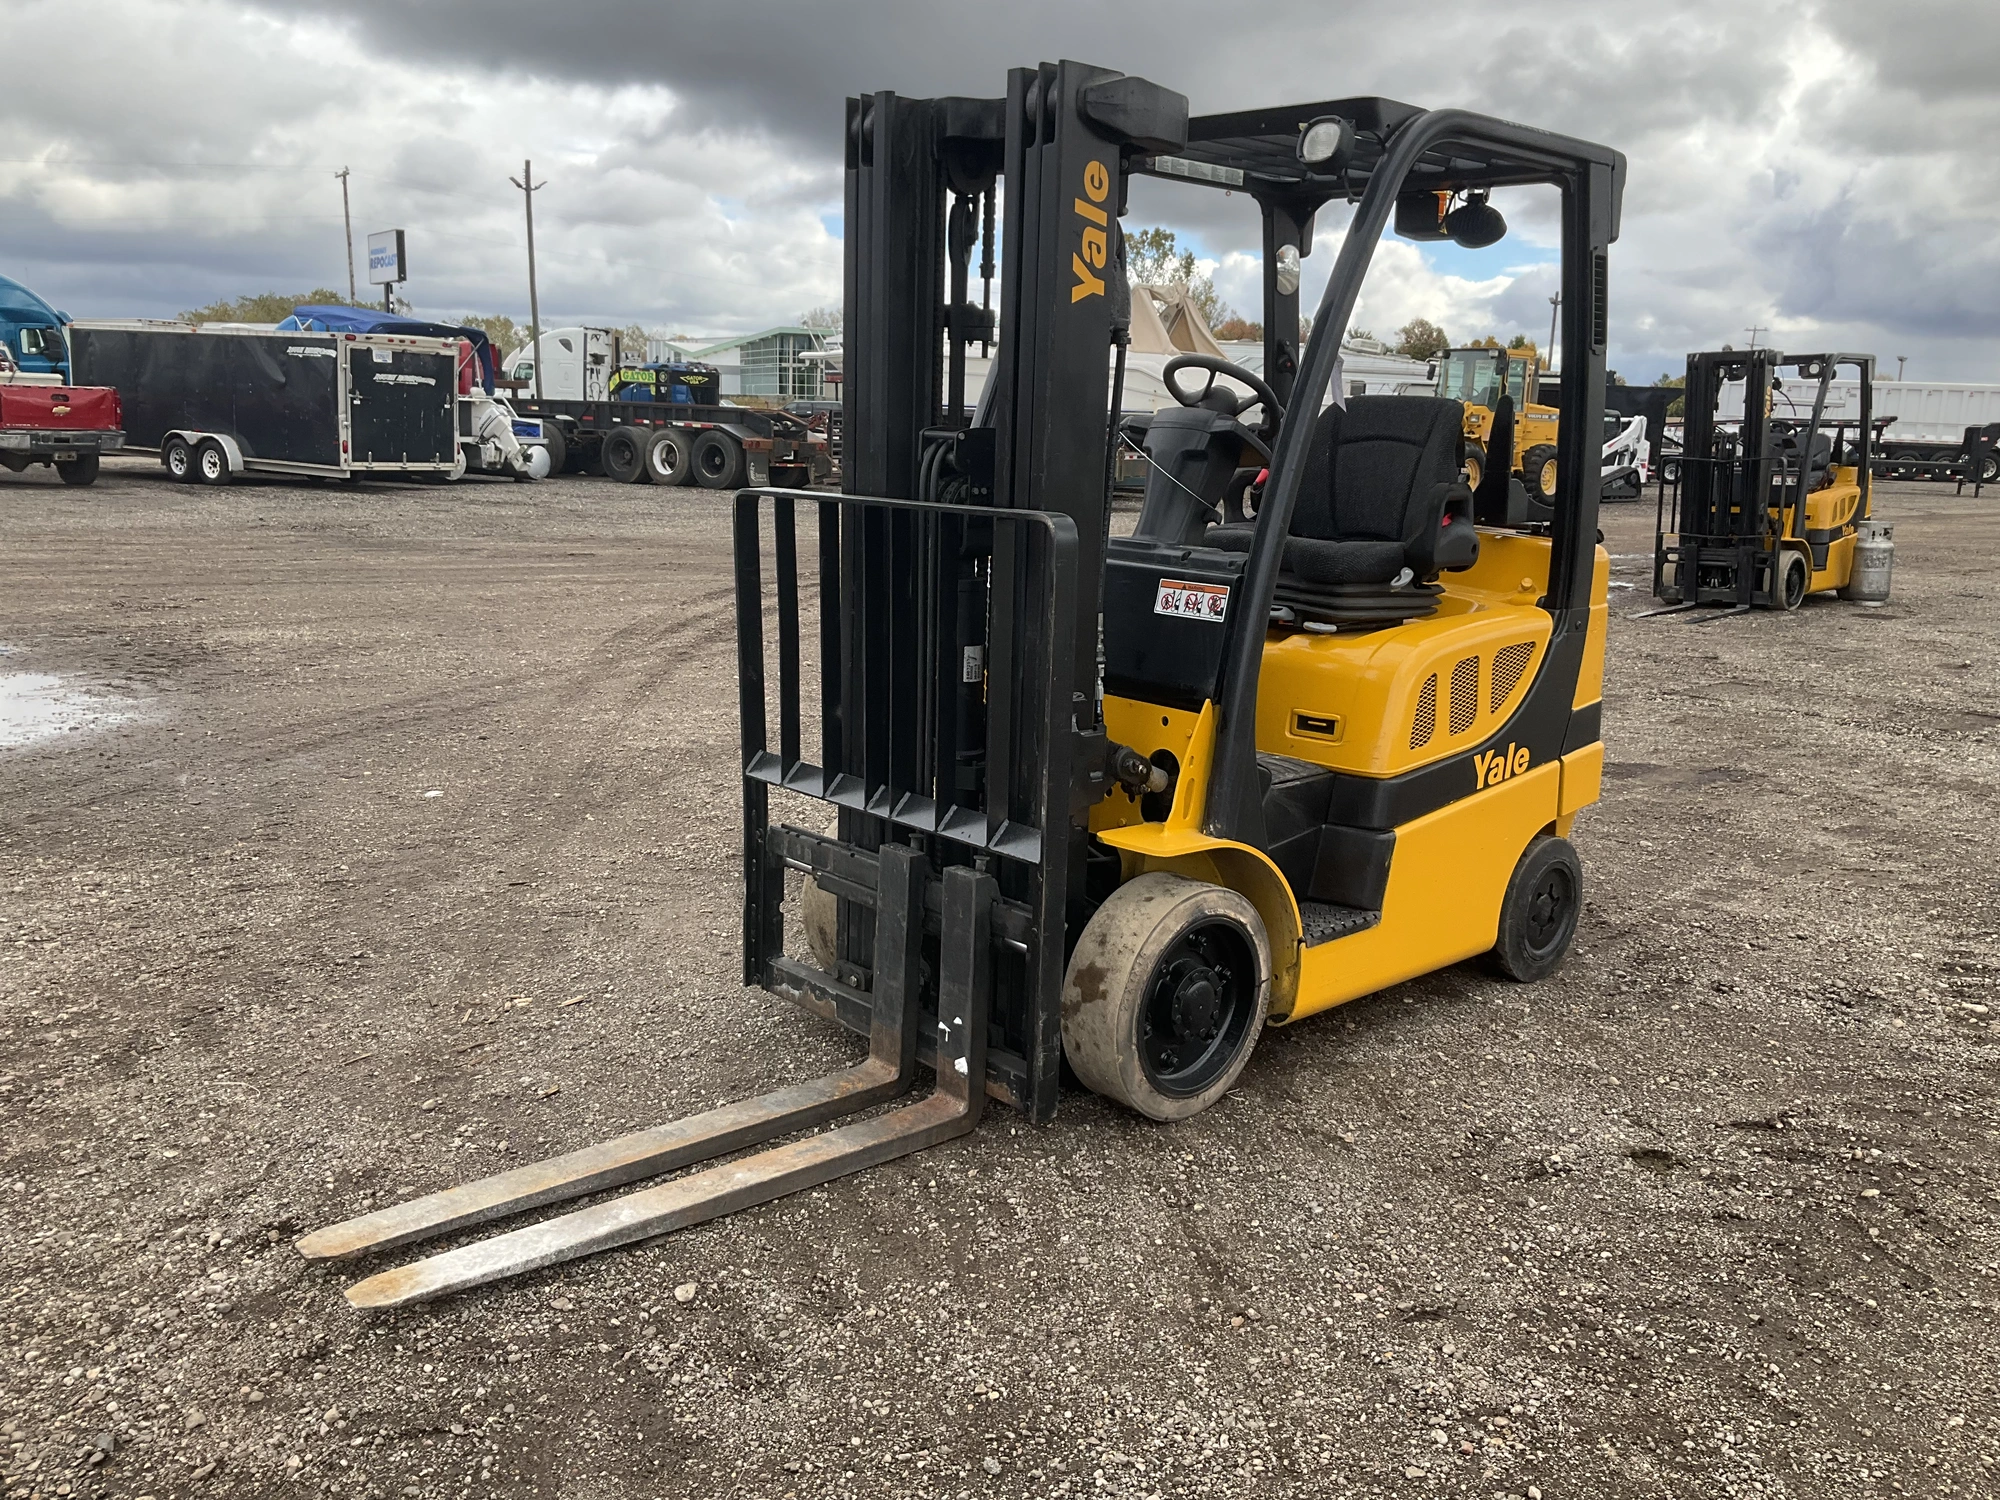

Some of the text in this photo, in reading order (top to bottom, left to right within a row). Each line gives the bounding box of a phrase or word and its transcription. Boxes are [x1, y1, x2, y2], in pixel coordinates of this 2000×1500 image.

[1071, 160, 1109, 304] Yale
[370, 253, 397, 270] REPOCAST
[623, 371, 654, 381] GATOR
[1842, 524, 1855, 536] Yale
[1473, 742, 1530, 790] Yale
